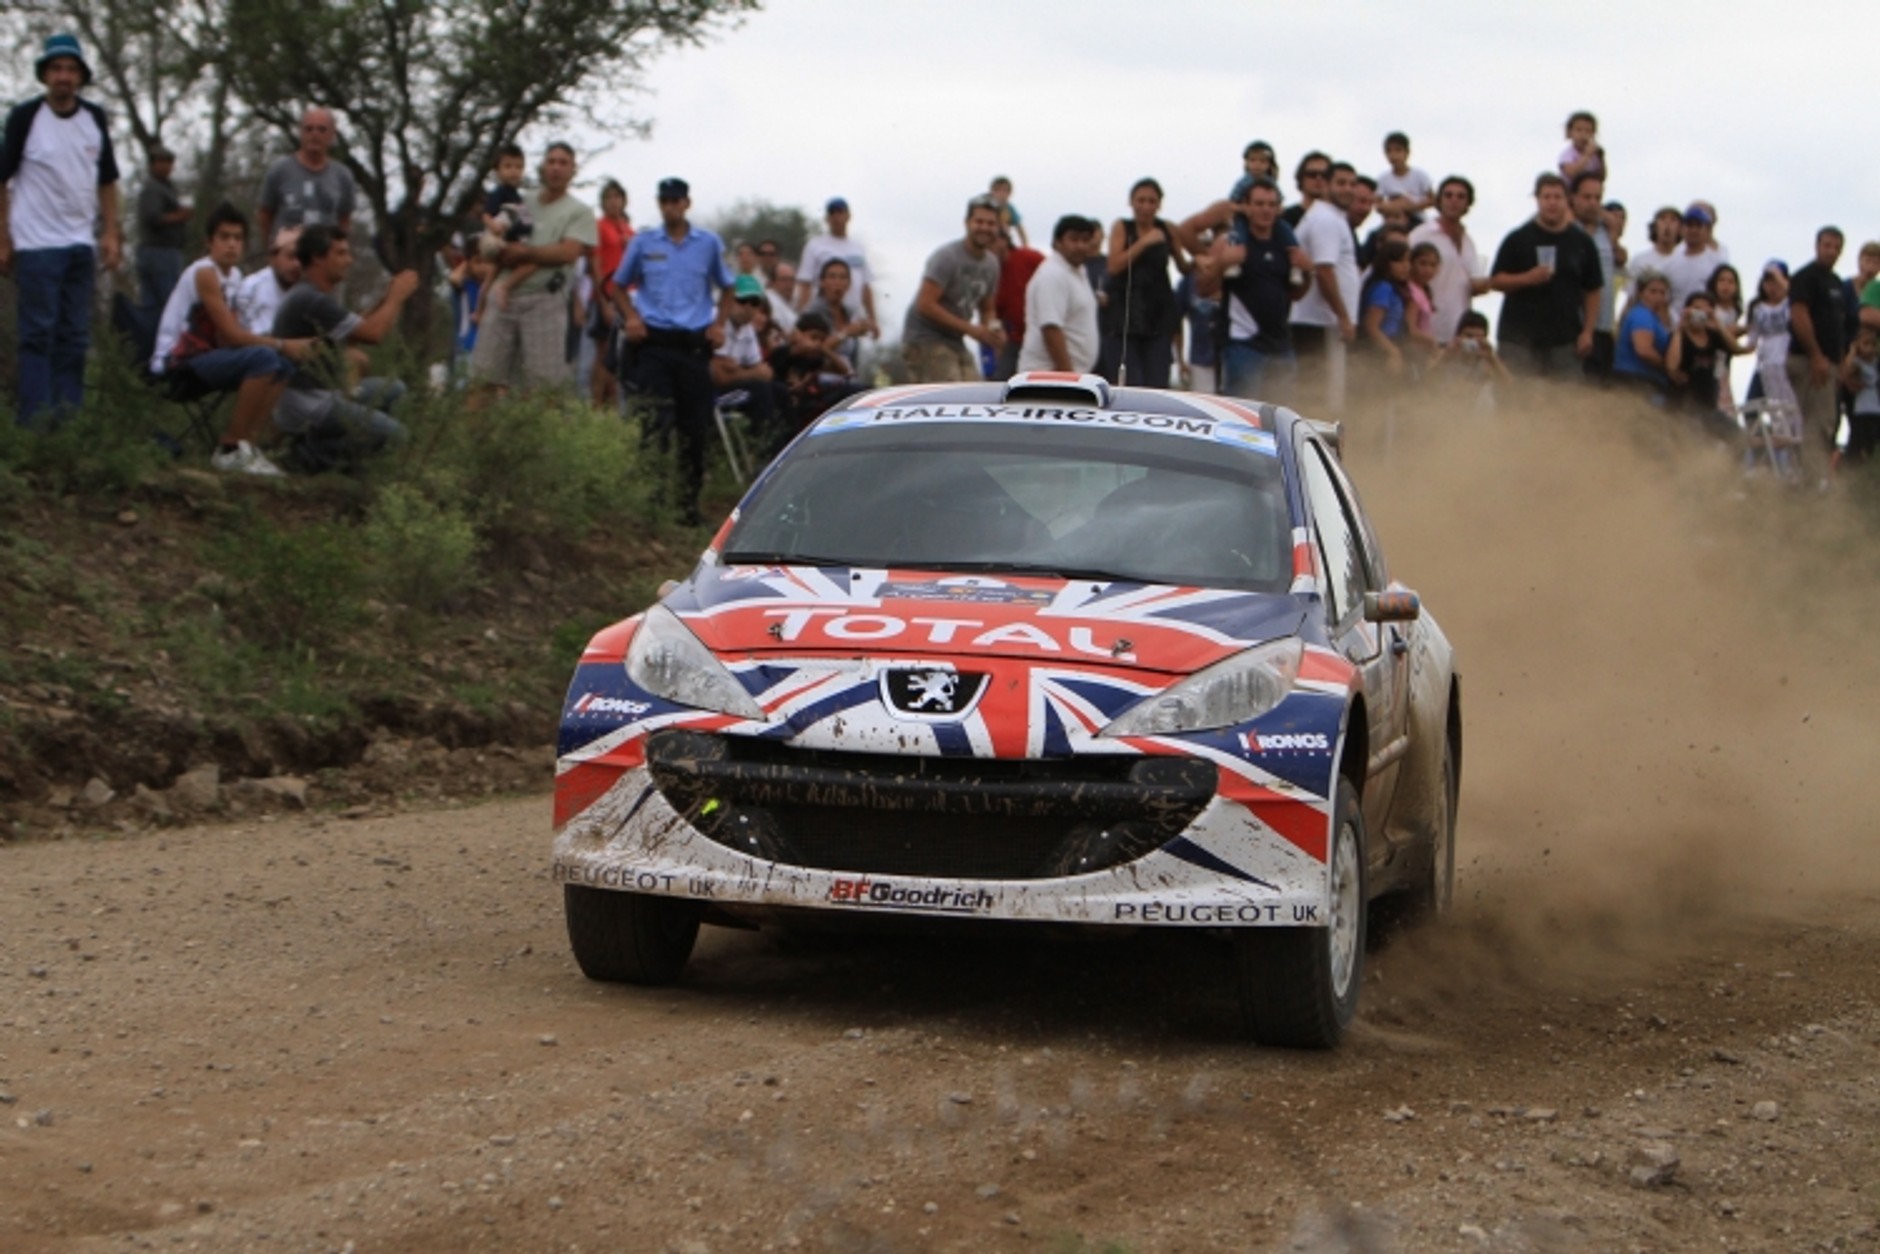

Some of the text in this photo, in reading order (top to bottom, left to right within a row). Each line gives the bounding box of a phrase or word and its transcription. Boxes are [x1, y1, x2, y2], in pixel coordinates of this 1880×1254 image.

[763, 608, 1137, 662] TOTAL
[1238, 730, 1329, 752] KRONOS
[552, 863, 715, 896] PEUGEOT UK
[831, 880, 993, 908] BFGoodrich
[1115, 903, 1318, 921] PEUGEOT UK
